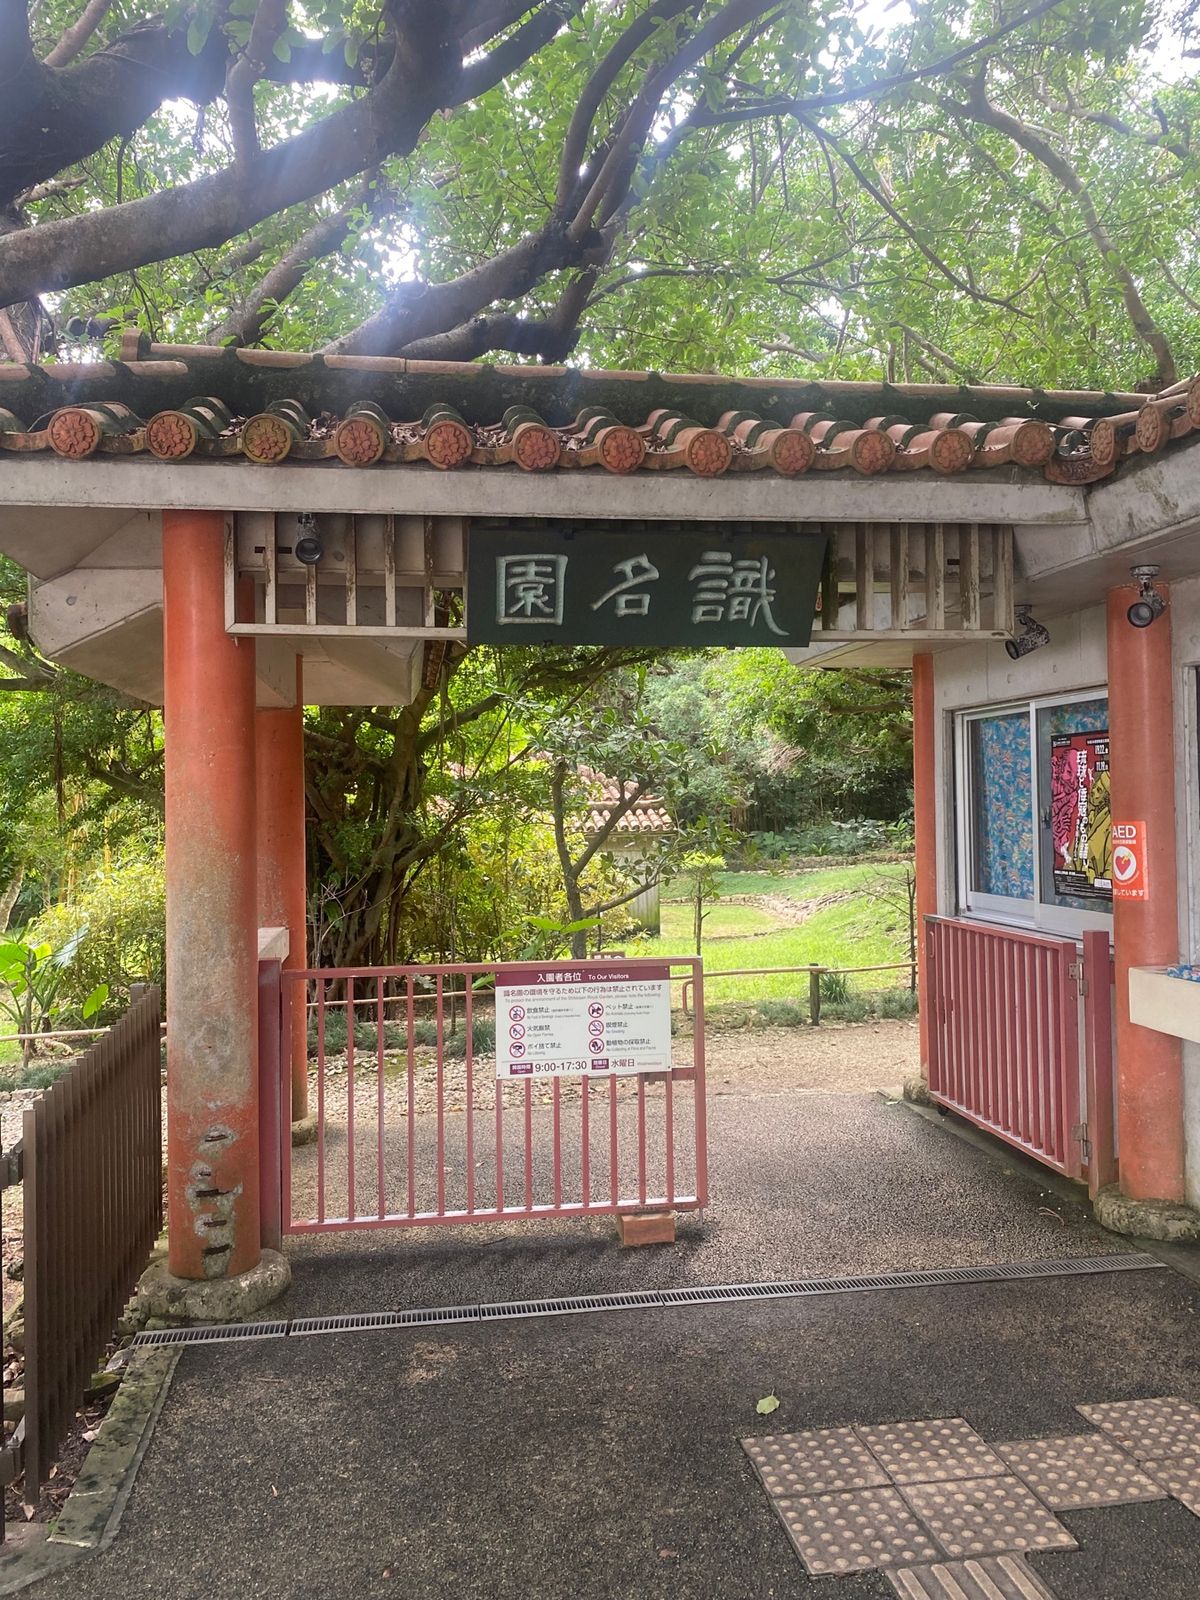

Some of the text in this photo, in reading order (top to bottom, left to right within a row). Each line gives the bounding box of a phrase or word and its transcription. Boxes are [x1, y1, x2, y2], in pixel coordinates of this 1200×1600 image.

[1112, 825, 1137, 838] AED
[537, 972, 582, 983] 入園者各位
[526, 1006, 550, 1014] 飲食禁止
[527, 1024, 551, 1032] 火気厳禁
[606, 1038, 651, 1046] 動植物の採取禁止
[535, 1060, 587, 1072] 9:00-17:30
[611, 1058, 635, 1067] 水曜日
